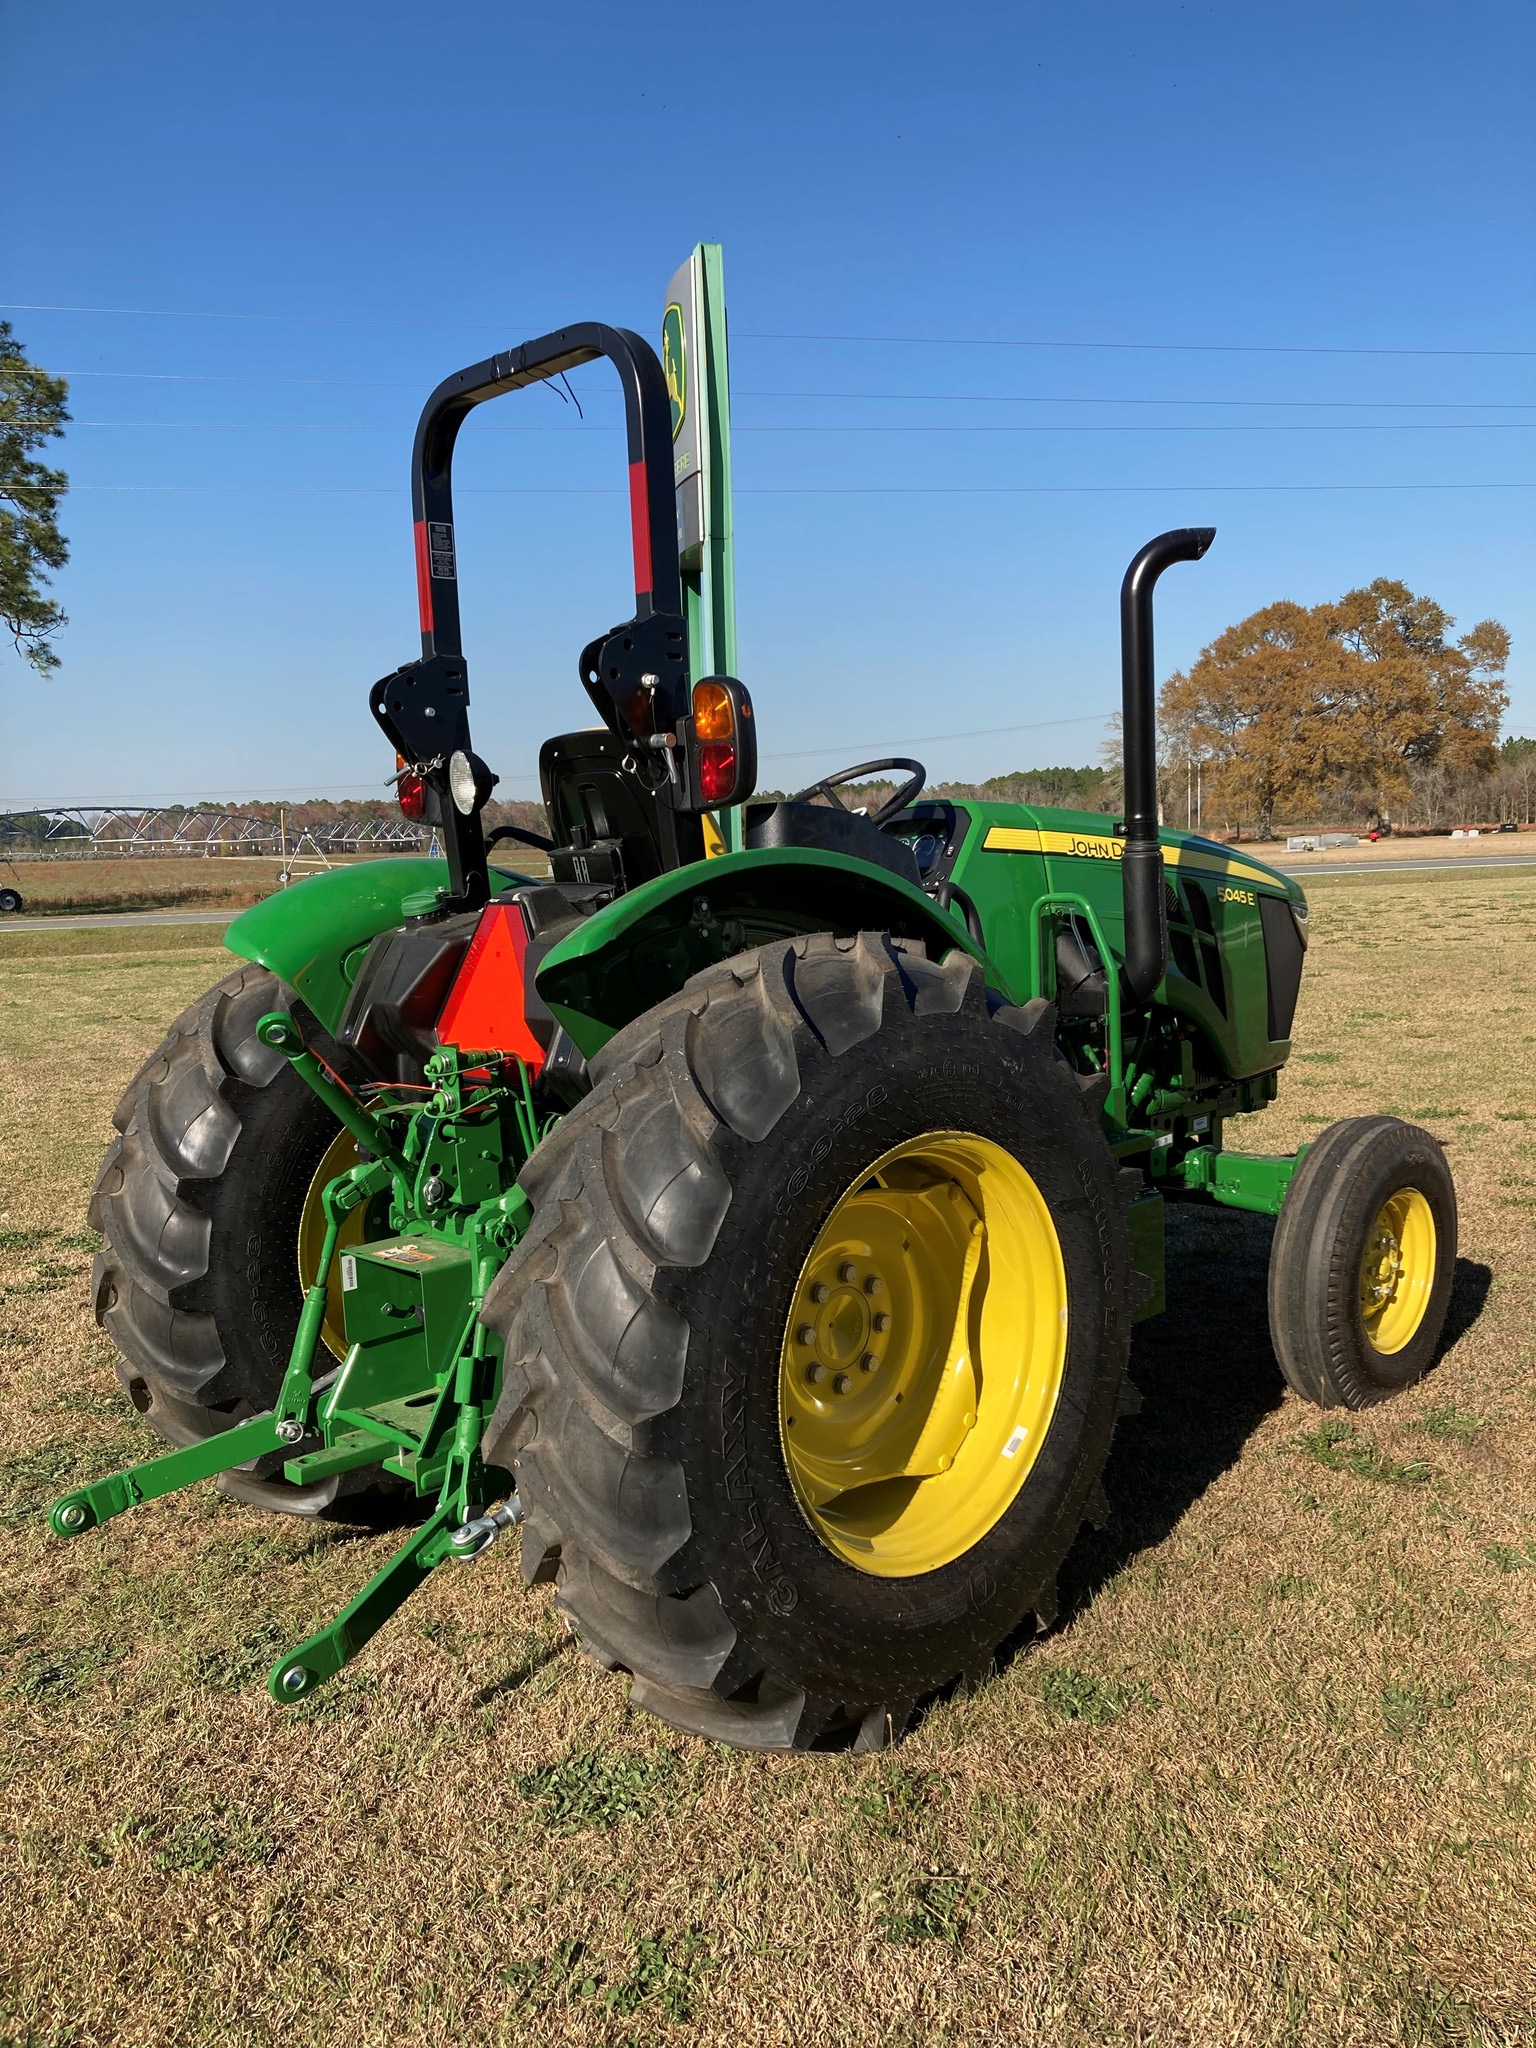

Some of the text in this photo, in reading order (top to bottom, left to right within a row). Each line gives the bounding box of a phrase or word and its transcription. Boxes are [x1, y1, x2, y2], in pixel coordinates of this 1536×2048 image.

[1067, 837, 1109, 857] JOHN
[776, 1085, 888, 1216] 16.9-28
[246, 1233, 285, 1368] 16.9-28
[720, 1358, 800, 1615] GALAXY
